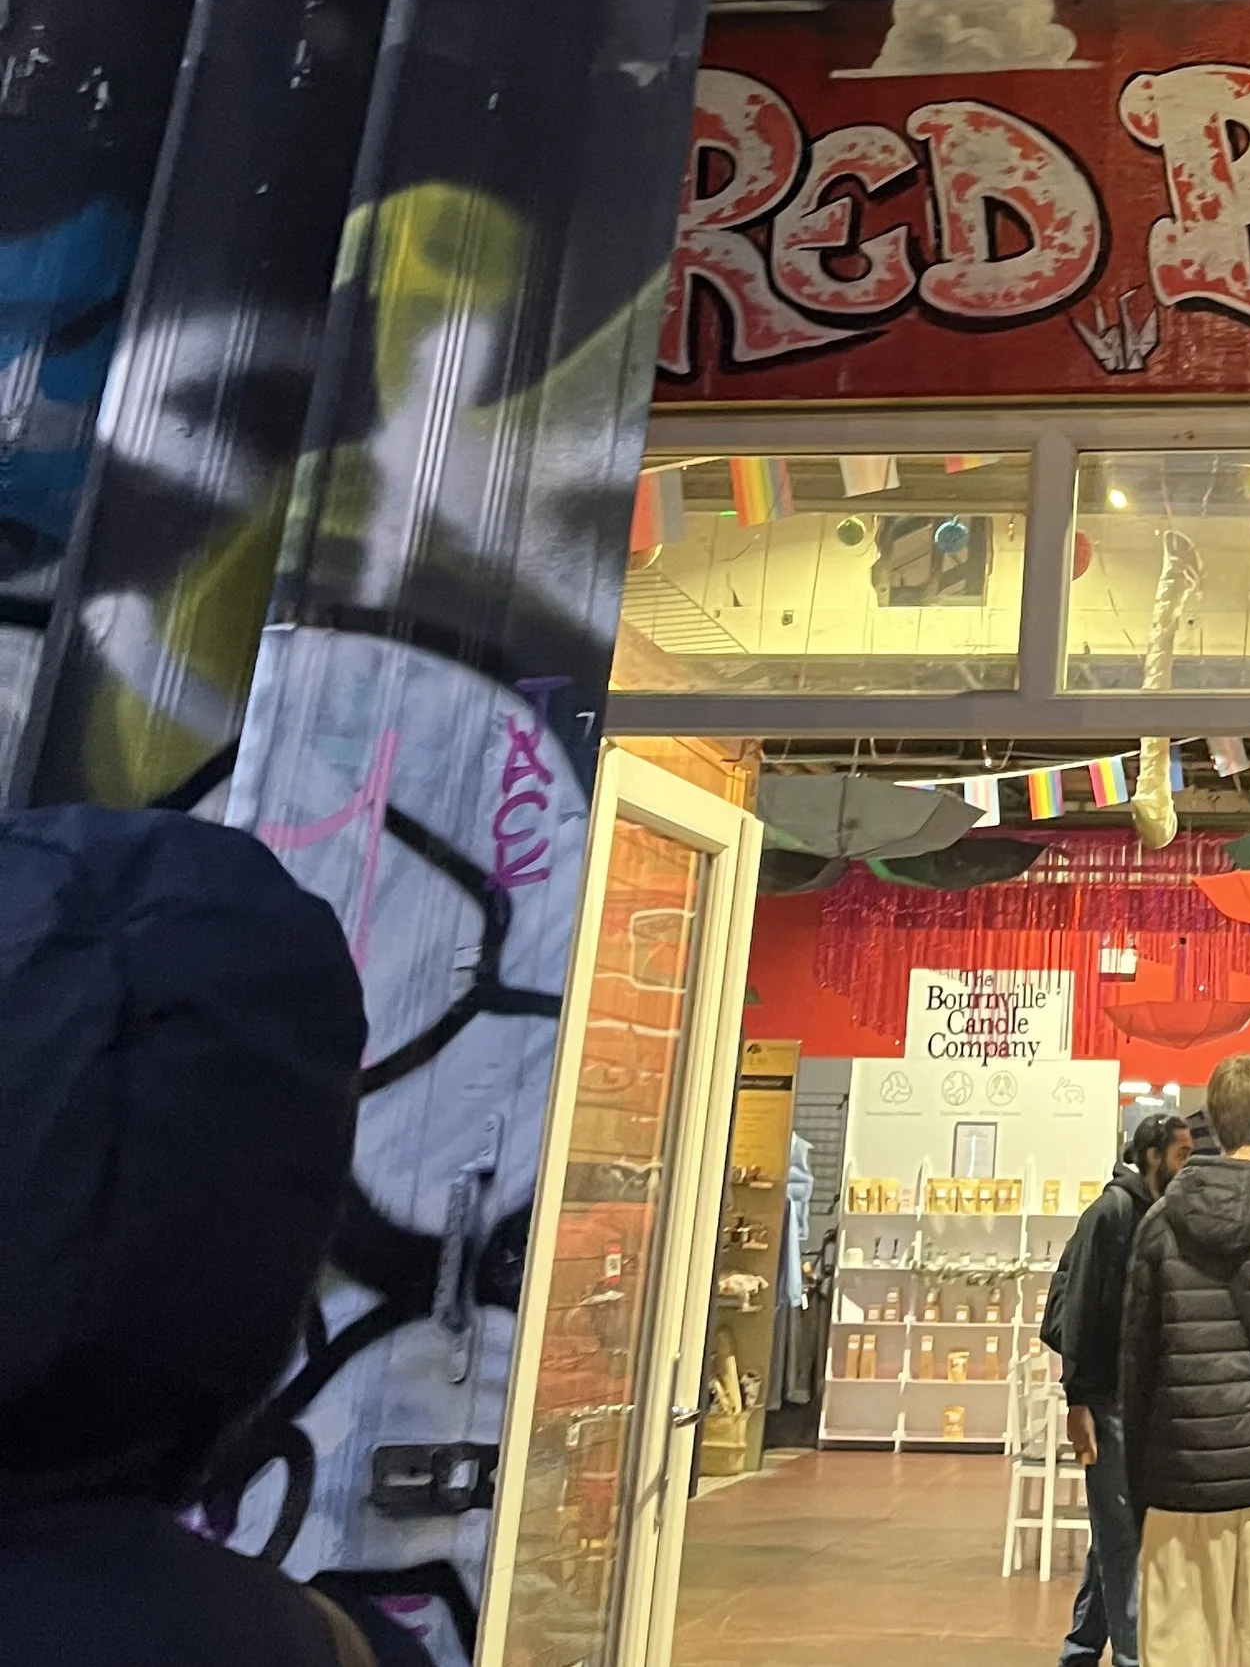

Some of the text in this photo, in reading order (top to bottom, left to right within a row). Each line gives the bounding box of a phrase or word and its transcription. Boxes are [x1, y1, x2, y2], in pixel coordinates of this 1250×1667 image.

[926, 984, 1047, 1011] Bournville
[947, 1006, 1030, 1035] Candle
[928, 1032, 1041, 1067] Company
